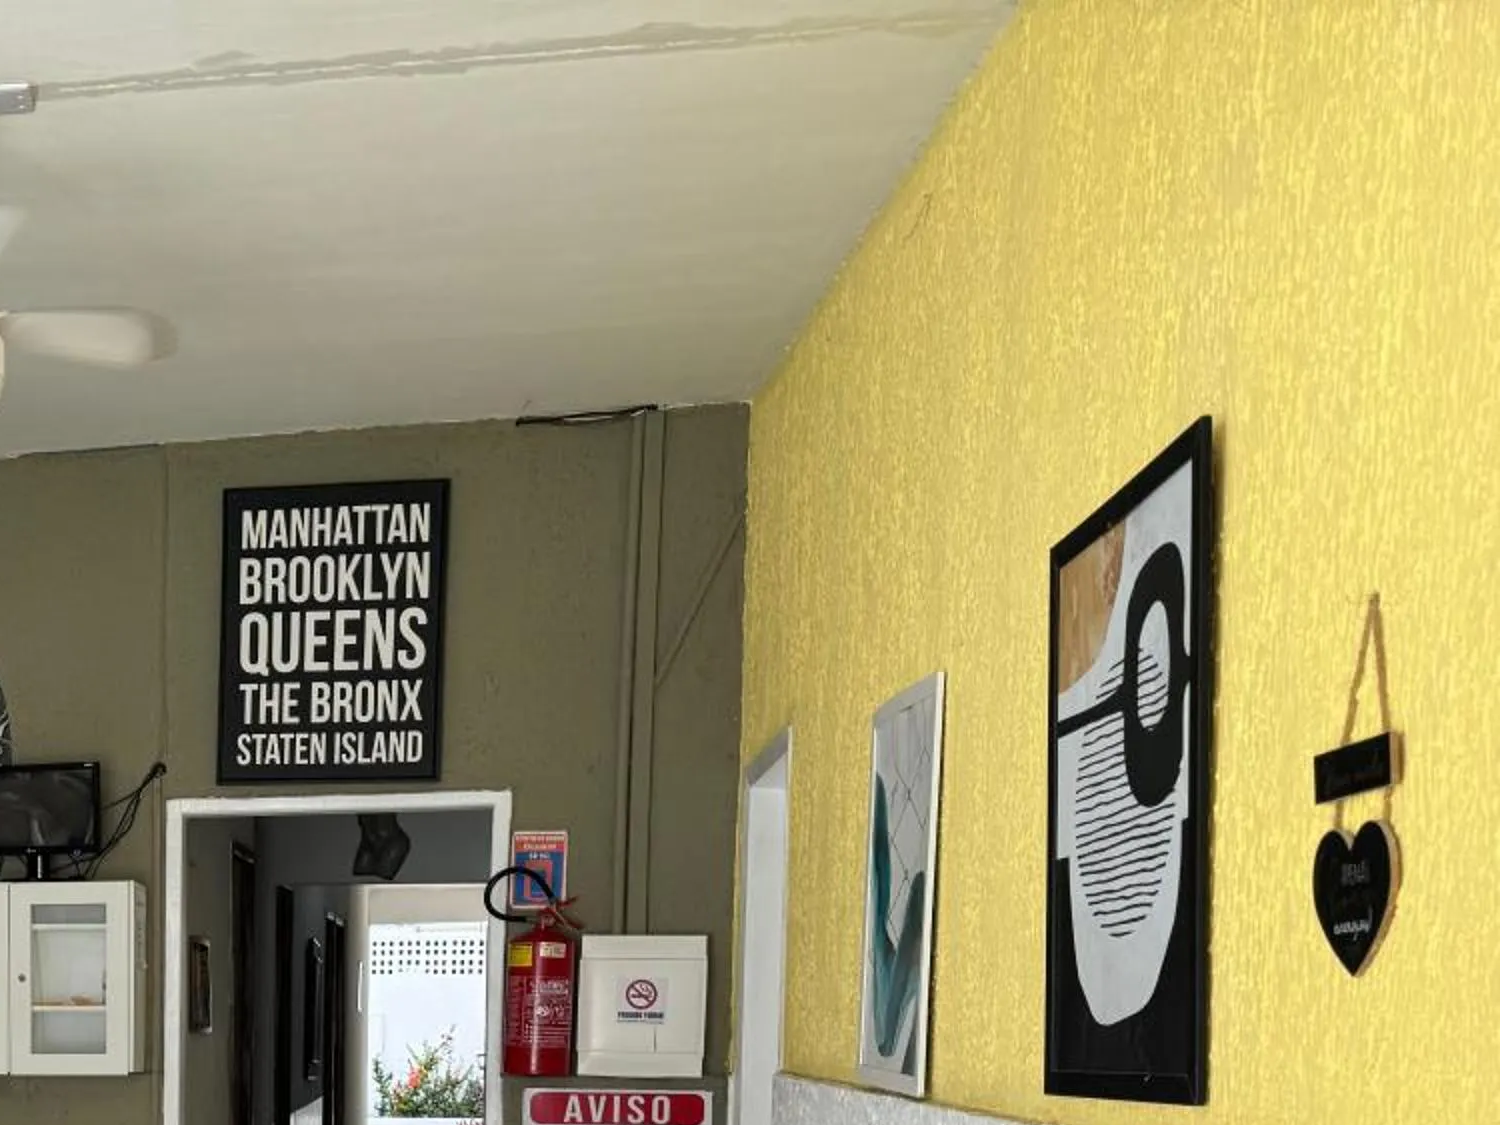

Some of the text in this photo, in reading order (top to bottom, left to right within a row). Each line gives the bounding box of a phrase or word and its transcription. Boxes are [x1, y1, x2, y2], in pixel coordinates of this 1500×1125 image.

[241, 503, 431, 550] MANHATTAN
[239, 552, 431, 605] BROOKLYN
[239, 607, 429, 676] QUEENS
[239, 679, 423, 725] THE BRONX
[236, 730, 423, 765] STATEN ISLAND
[563, 1094, 671, 1125] AVISO
